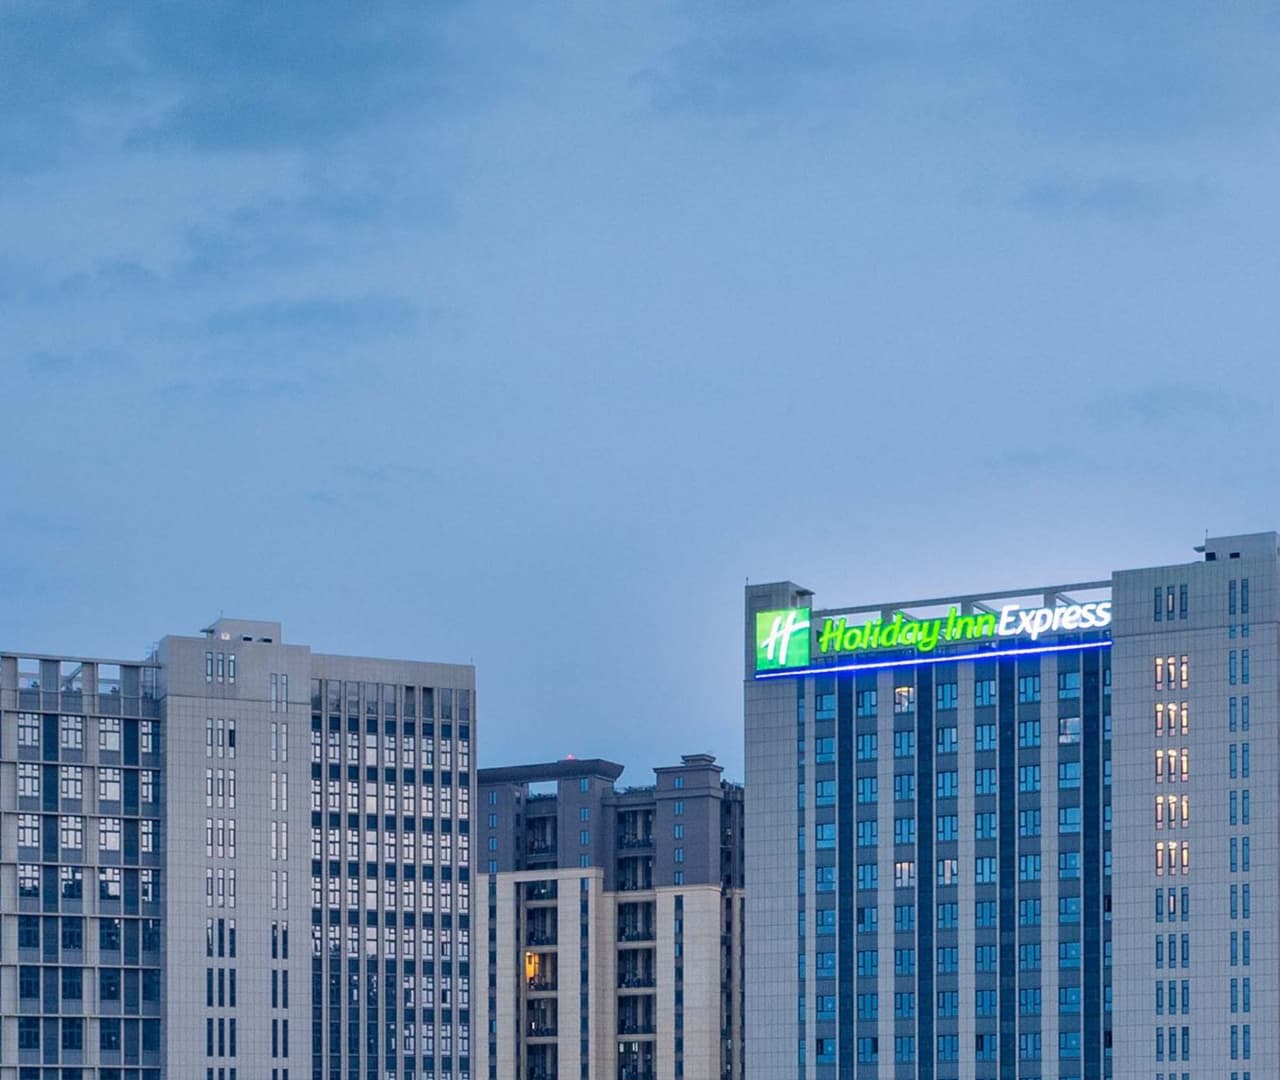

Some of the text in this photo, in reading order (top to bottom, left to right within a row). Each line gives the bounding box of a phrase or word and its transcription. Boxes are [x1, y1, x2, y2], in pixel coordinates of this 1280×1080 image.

[818, 601, 1113, 654] Holiday Inn Express
